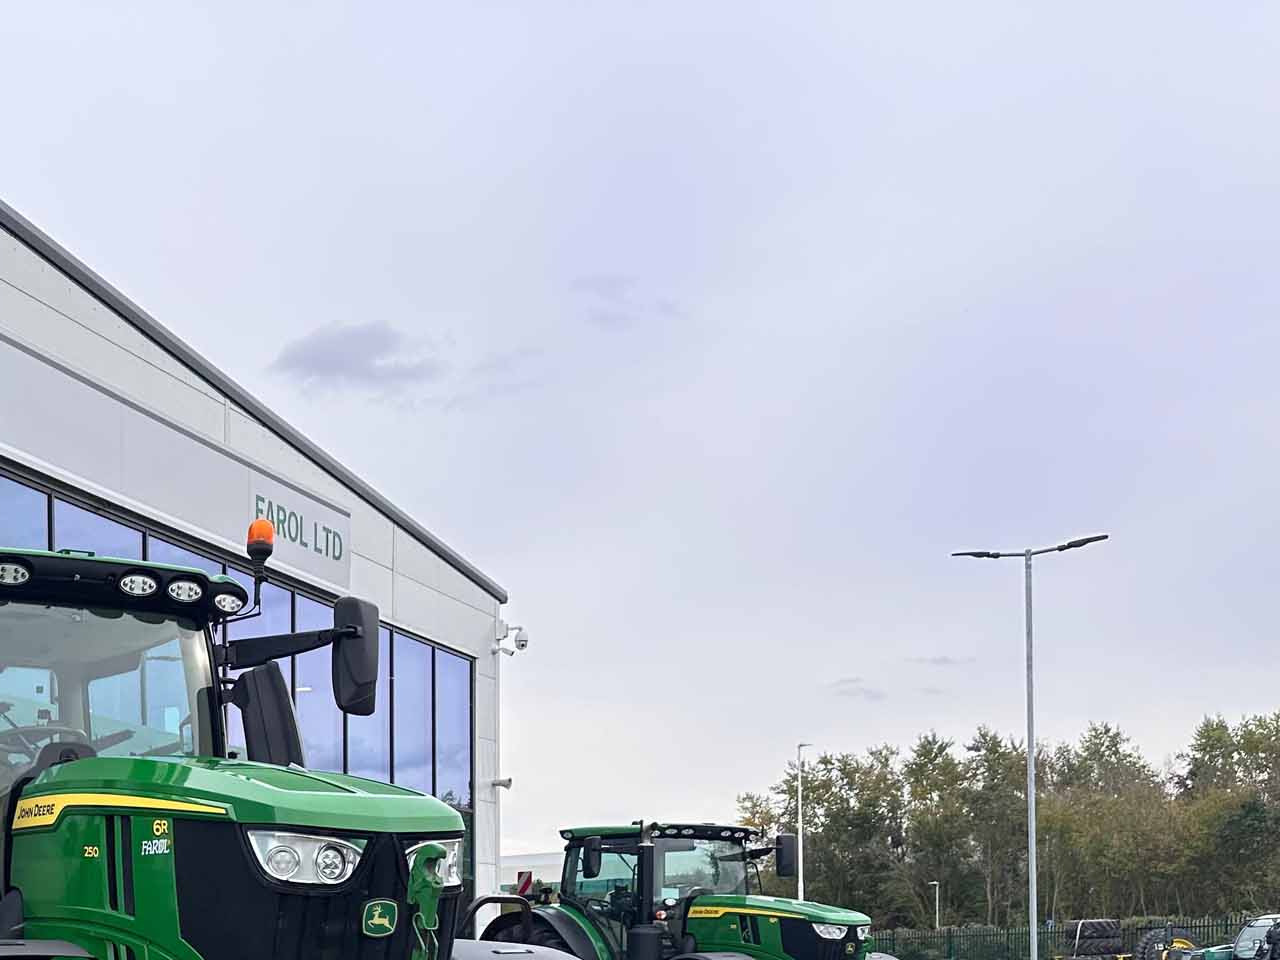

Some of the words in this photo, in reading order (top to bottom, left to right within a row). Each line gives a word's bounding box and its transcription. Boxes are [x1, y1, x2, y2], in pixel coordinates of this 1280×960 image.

[256, 494, 308, 548] FAROL
[314, 521, 343, 561] LTD
[18, 805, 33, 819] JOHN
[34, 803, 55, 817] DEERE
[153, 819, 168, 836] 6R
[84, 846, 99, 858] 250
